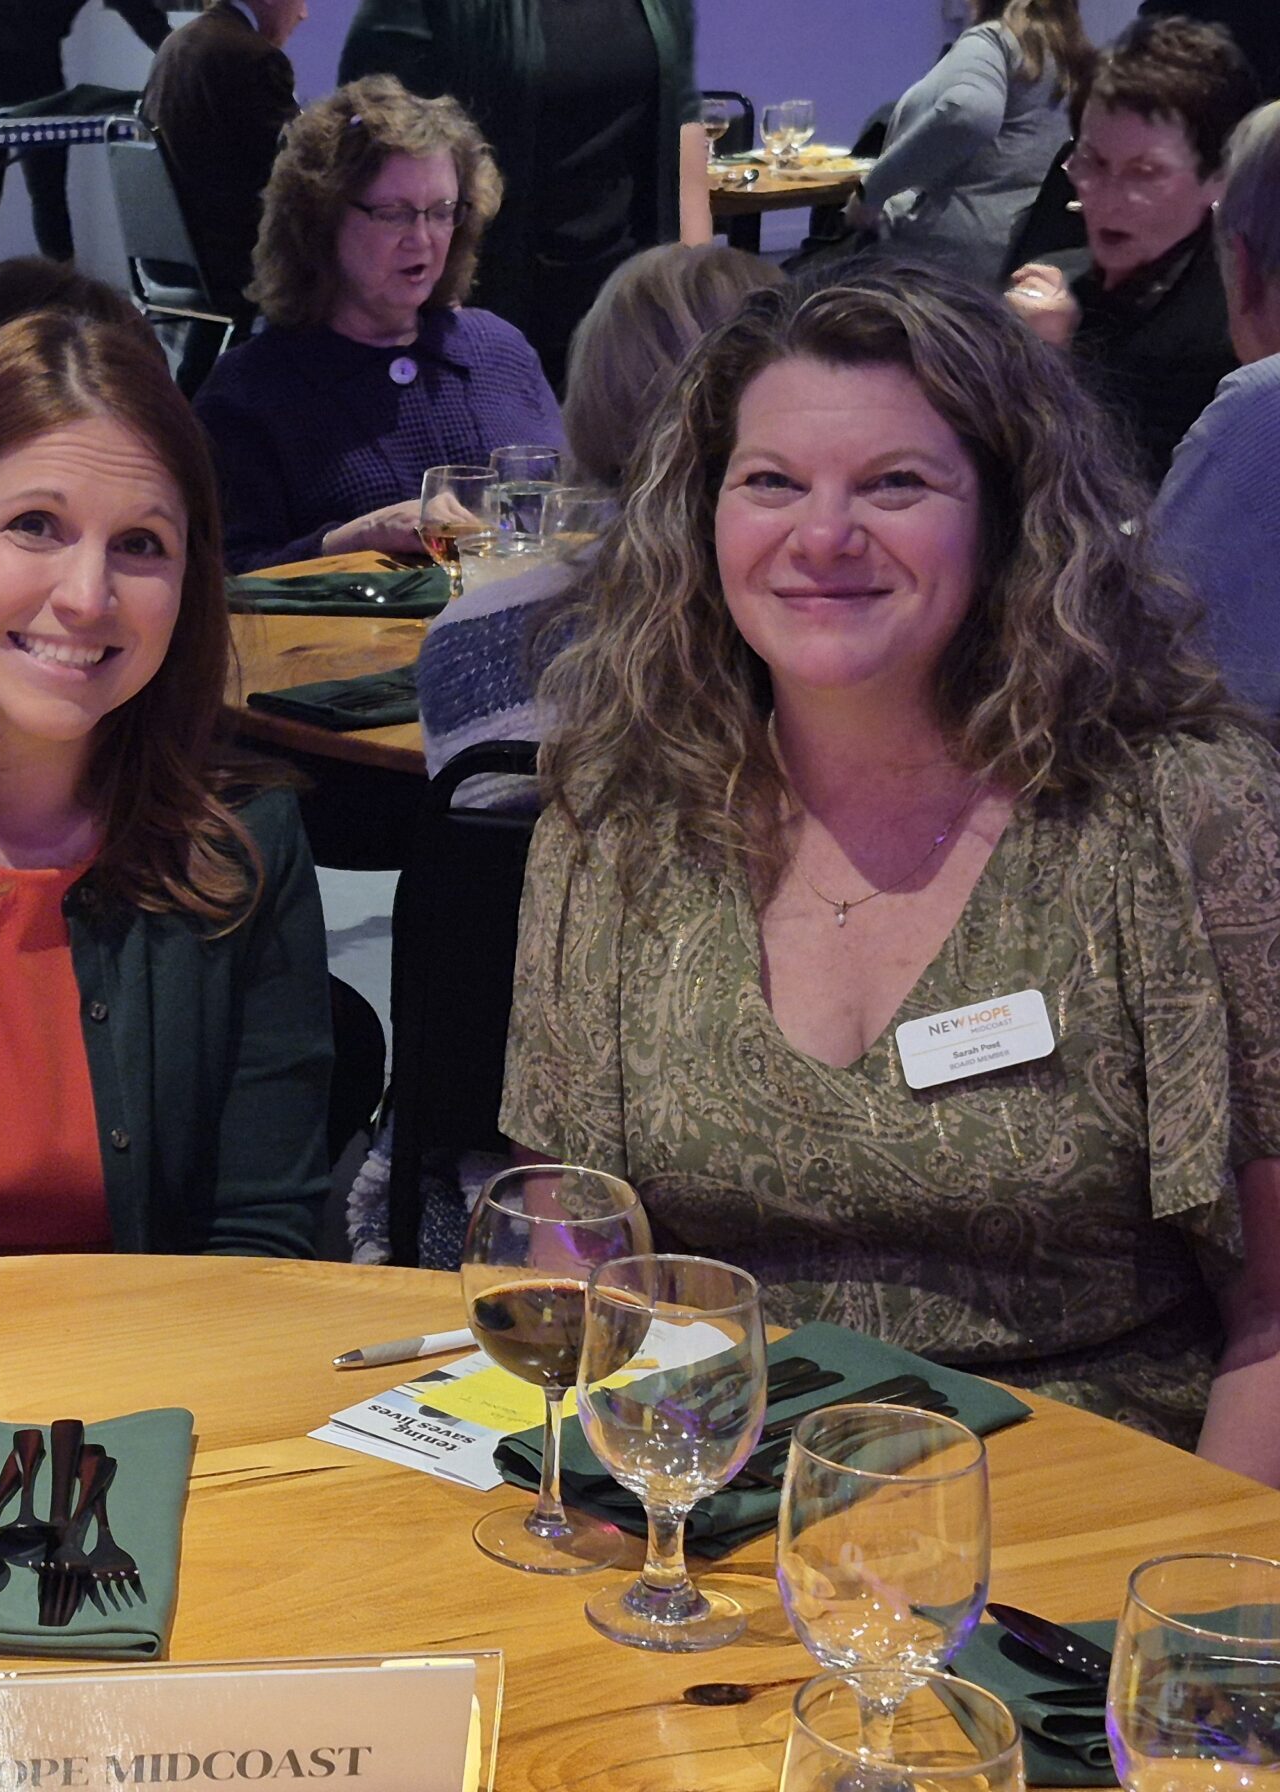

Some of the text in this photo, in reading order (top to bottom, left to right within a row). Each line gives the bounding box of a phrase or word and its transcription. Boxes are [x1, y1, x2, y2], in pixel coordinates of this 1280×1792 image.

[928, 1004, 1012, 1037] NEW HOPE
[949, 1050, 1010, 1070] BOARD MEMBER
[953, 1047, 979, 1059] Sarah
[367, 1403, 477, 1445] saves lives
[105, 1746, 373, 1785] MIDCOAST
